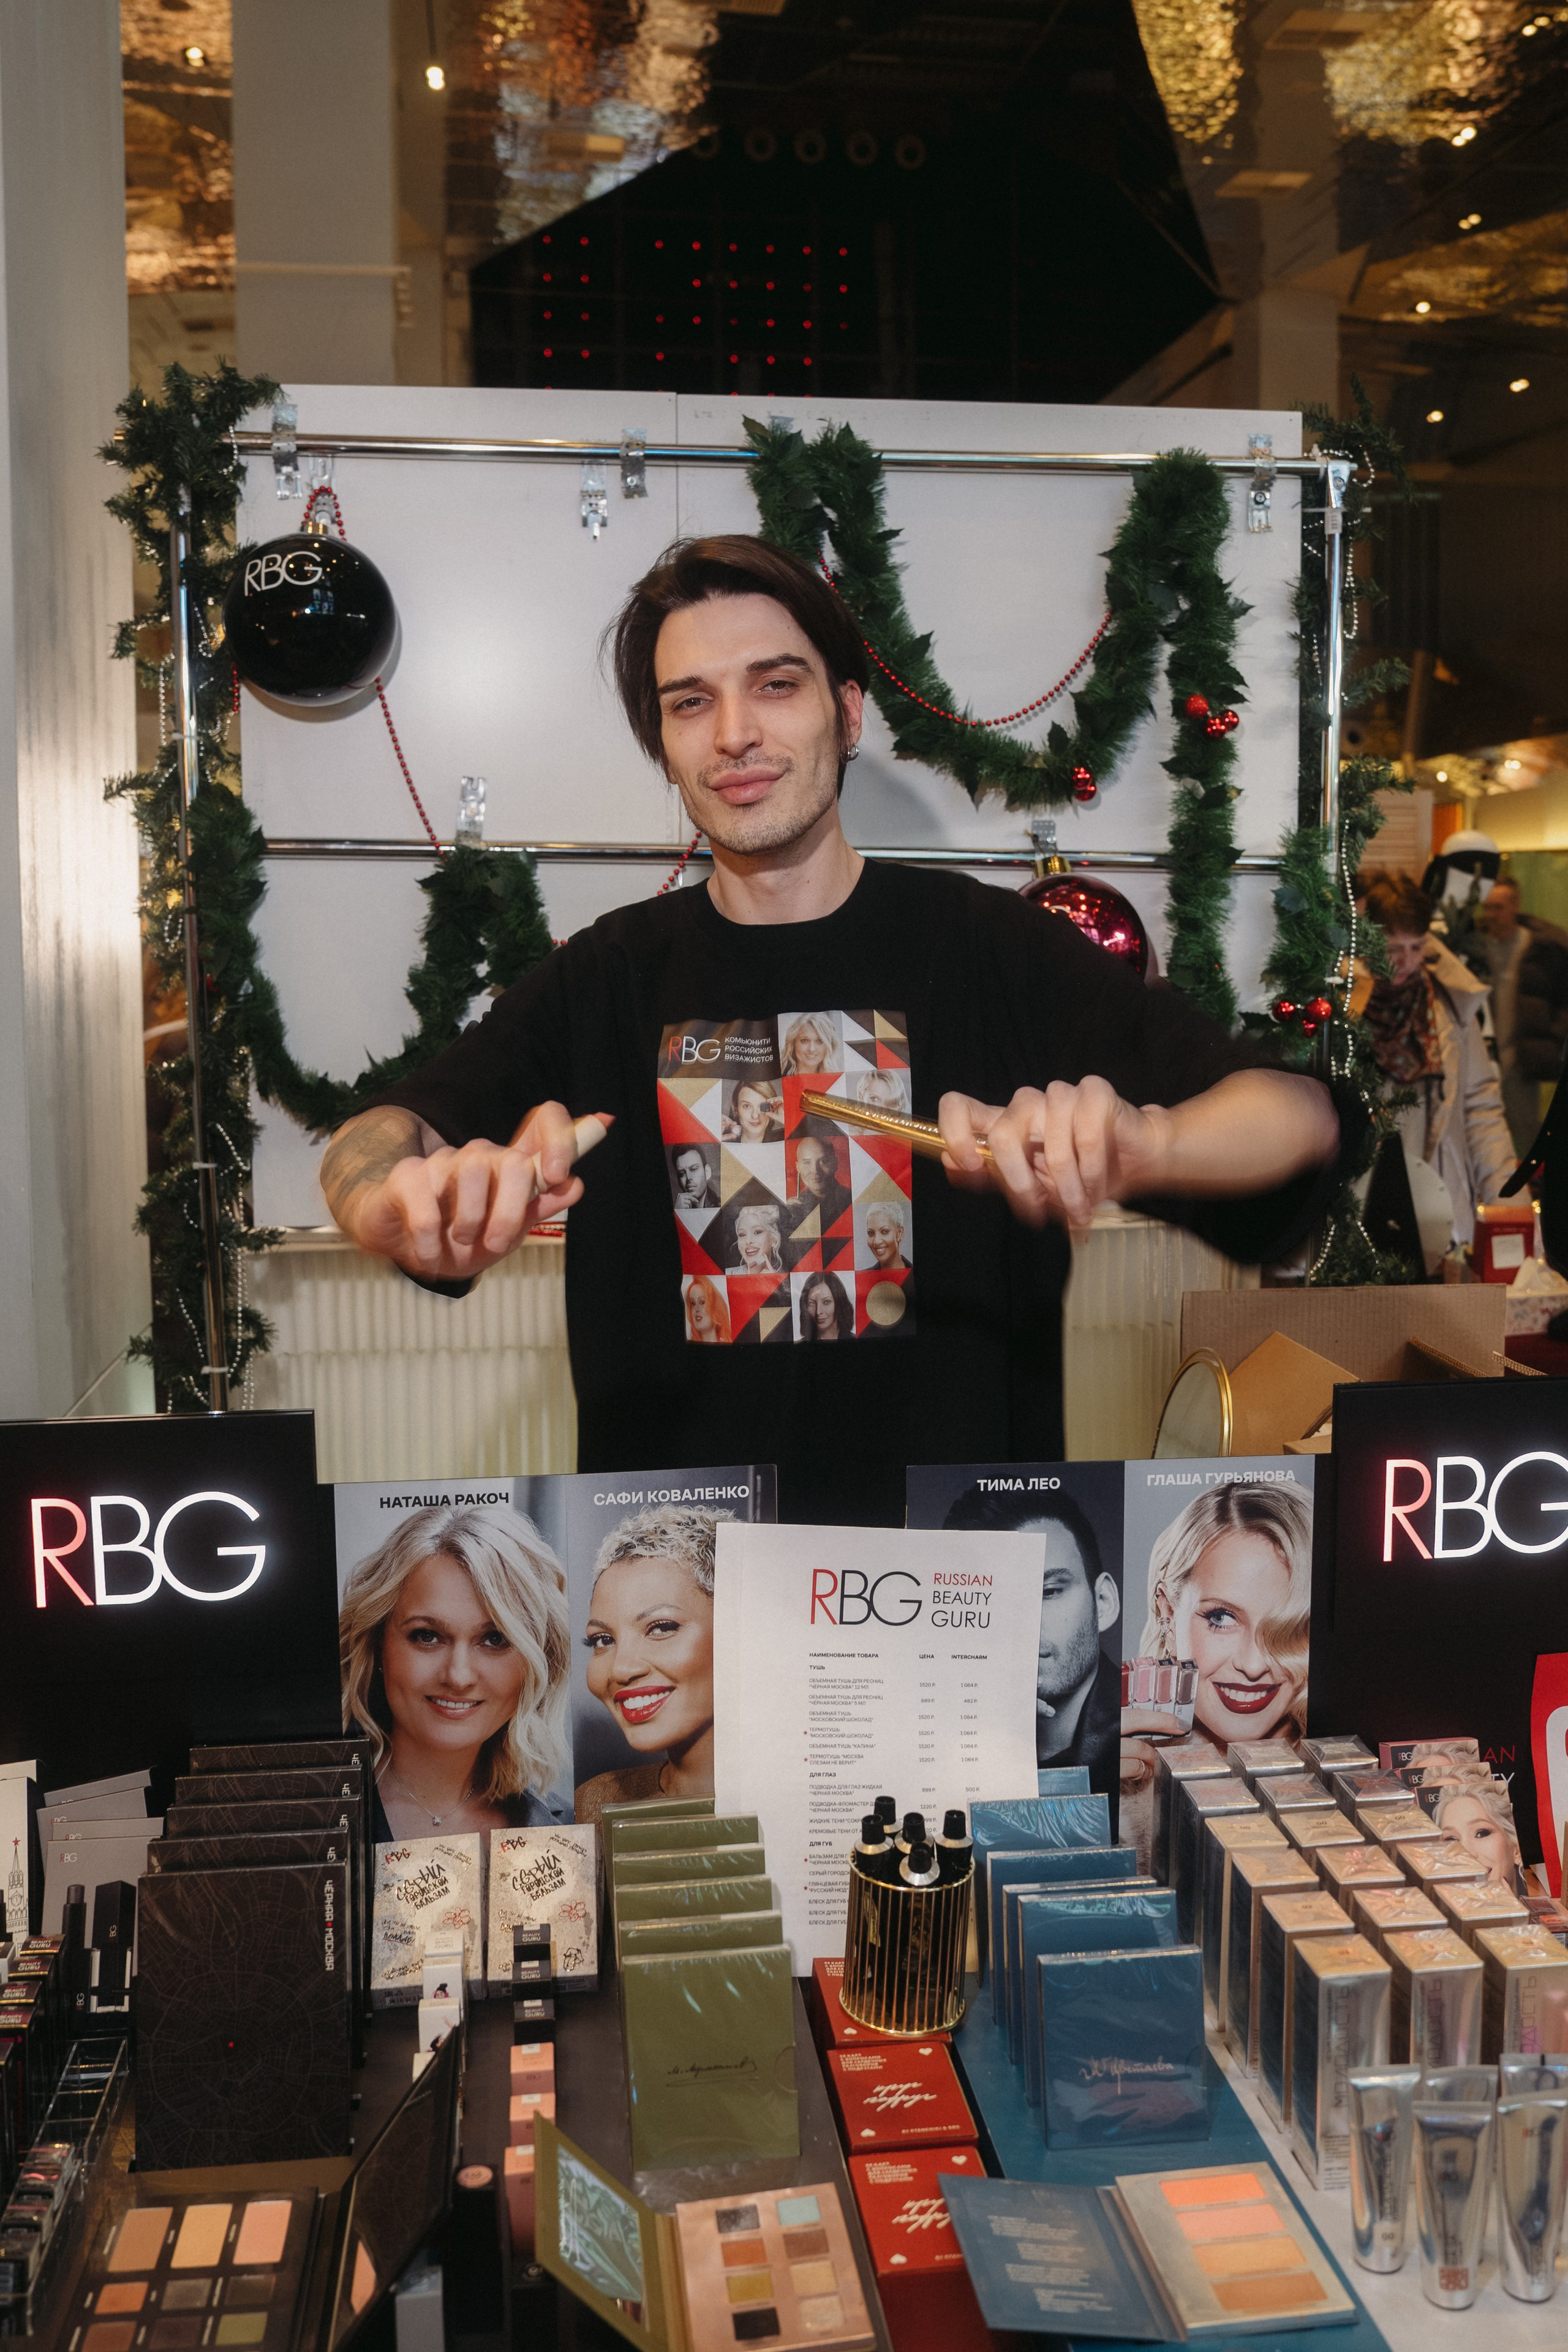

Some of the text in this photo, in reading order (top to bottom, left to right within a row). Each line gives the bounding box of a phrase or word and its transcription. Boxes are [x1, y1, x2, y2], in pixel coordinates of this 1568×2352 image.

[244, 551, 322, 597] RBG
[668, 1036, 721, 1064] RBG
[725, 1036, 771, 1045] КОМЬЮНИТИ
[725, 1045, 772, 1054] РОССИЙСКИХ
[725, 1054, 774, 1062] ВИЗАЖИСТОВ
[977, 1477, 1061, 1491] ТИМА ЛЕО
[1147, 1470, 1295, 1486] ГЛАША ГУРЬЯНОВА
[380, 1492, 510, 1509] НАТАША РАКОЧ
[594, 1485, 750, 1506] САФИ КОВАЛЕНКО
[1383, 1451, 1568, 1562] RBG
[31, 1491, 266, 1608] RBG
[933, 1572, 993, 1587] RUSSIAN
[810, 1569, 922, 1626] RBG
[932, 1591, 992, 1606] BEAUTY
[931, 1610, 991, 1629] GURU
[59, 1853, 78, 1863] RBG
[414, 1887, 450, 1910] БАЛЬЗАМ
[530, 1878, 566, 1902] БАЛЬЗАМ
[324, 1928, 334, 1972] МОСКВА
